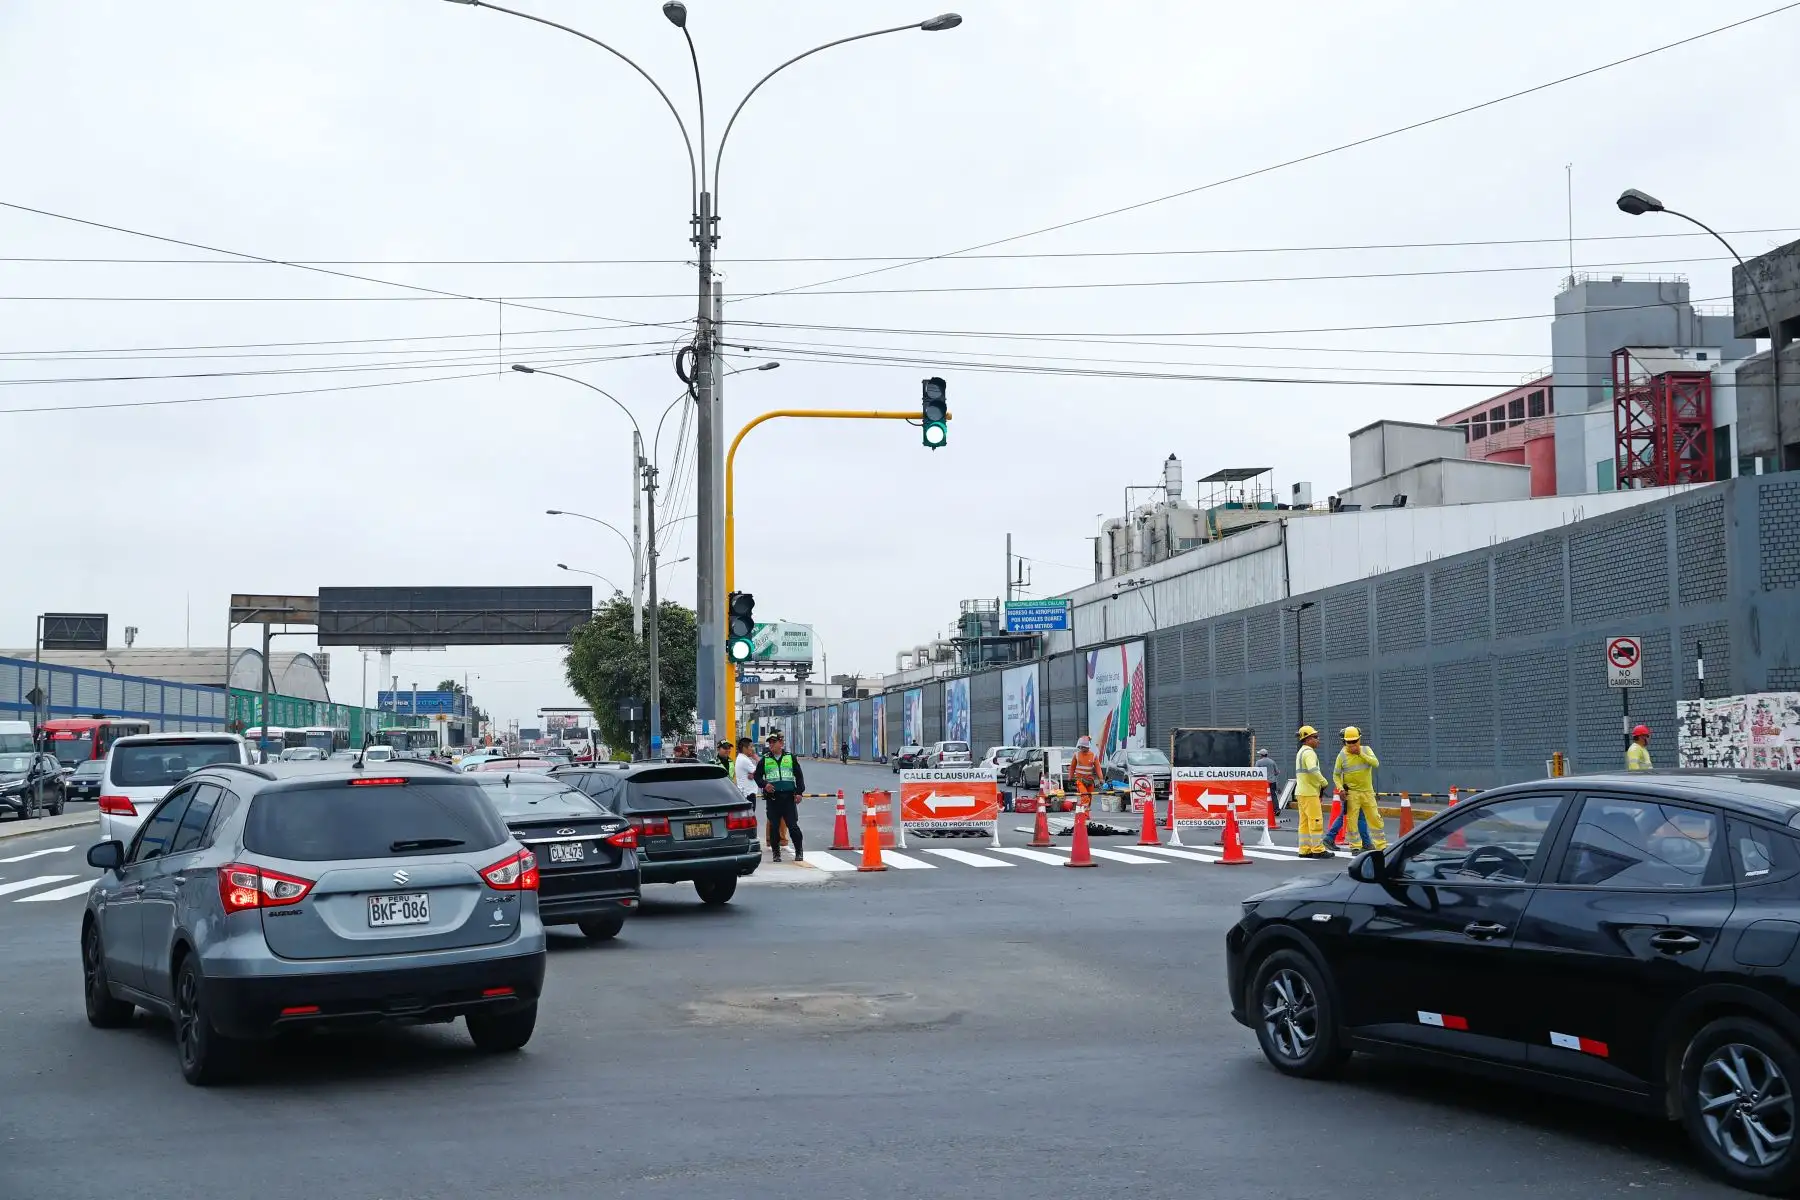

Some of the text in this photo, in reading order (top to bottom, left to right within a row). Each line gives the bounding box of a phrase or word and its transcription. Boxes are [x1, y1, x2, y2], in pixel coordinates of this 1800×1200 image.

[904, 772, 993, 780] CALLE CLAUSURADA
[1207, 770, 1264, 778] CLAUSURADA
[551, 847, 583, 860] CLX-473
[372, 900, 428, 921] BKF-086
